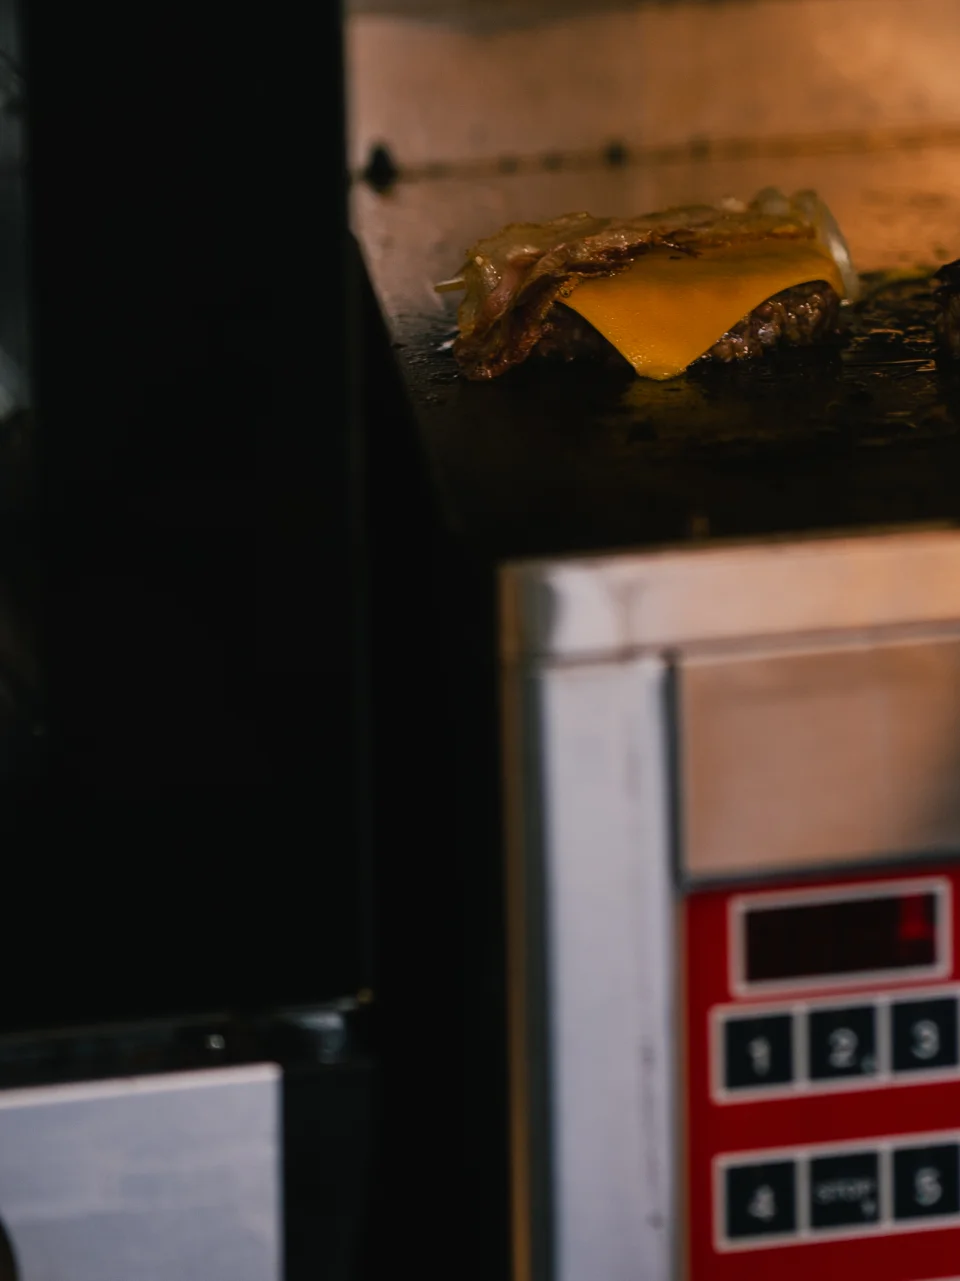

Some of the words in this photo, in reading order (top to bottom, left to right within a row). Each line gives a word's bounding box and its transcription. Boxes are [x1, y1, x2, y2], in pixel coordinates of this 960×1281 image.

[747, 1034, 772, 1076] 1
[828, 1026, 859, 1069] 2
[909, 1018, 941, 1060] 3
[747, 1183, 777, 1222] 4
[914, 1166, 944, 1208] 5
